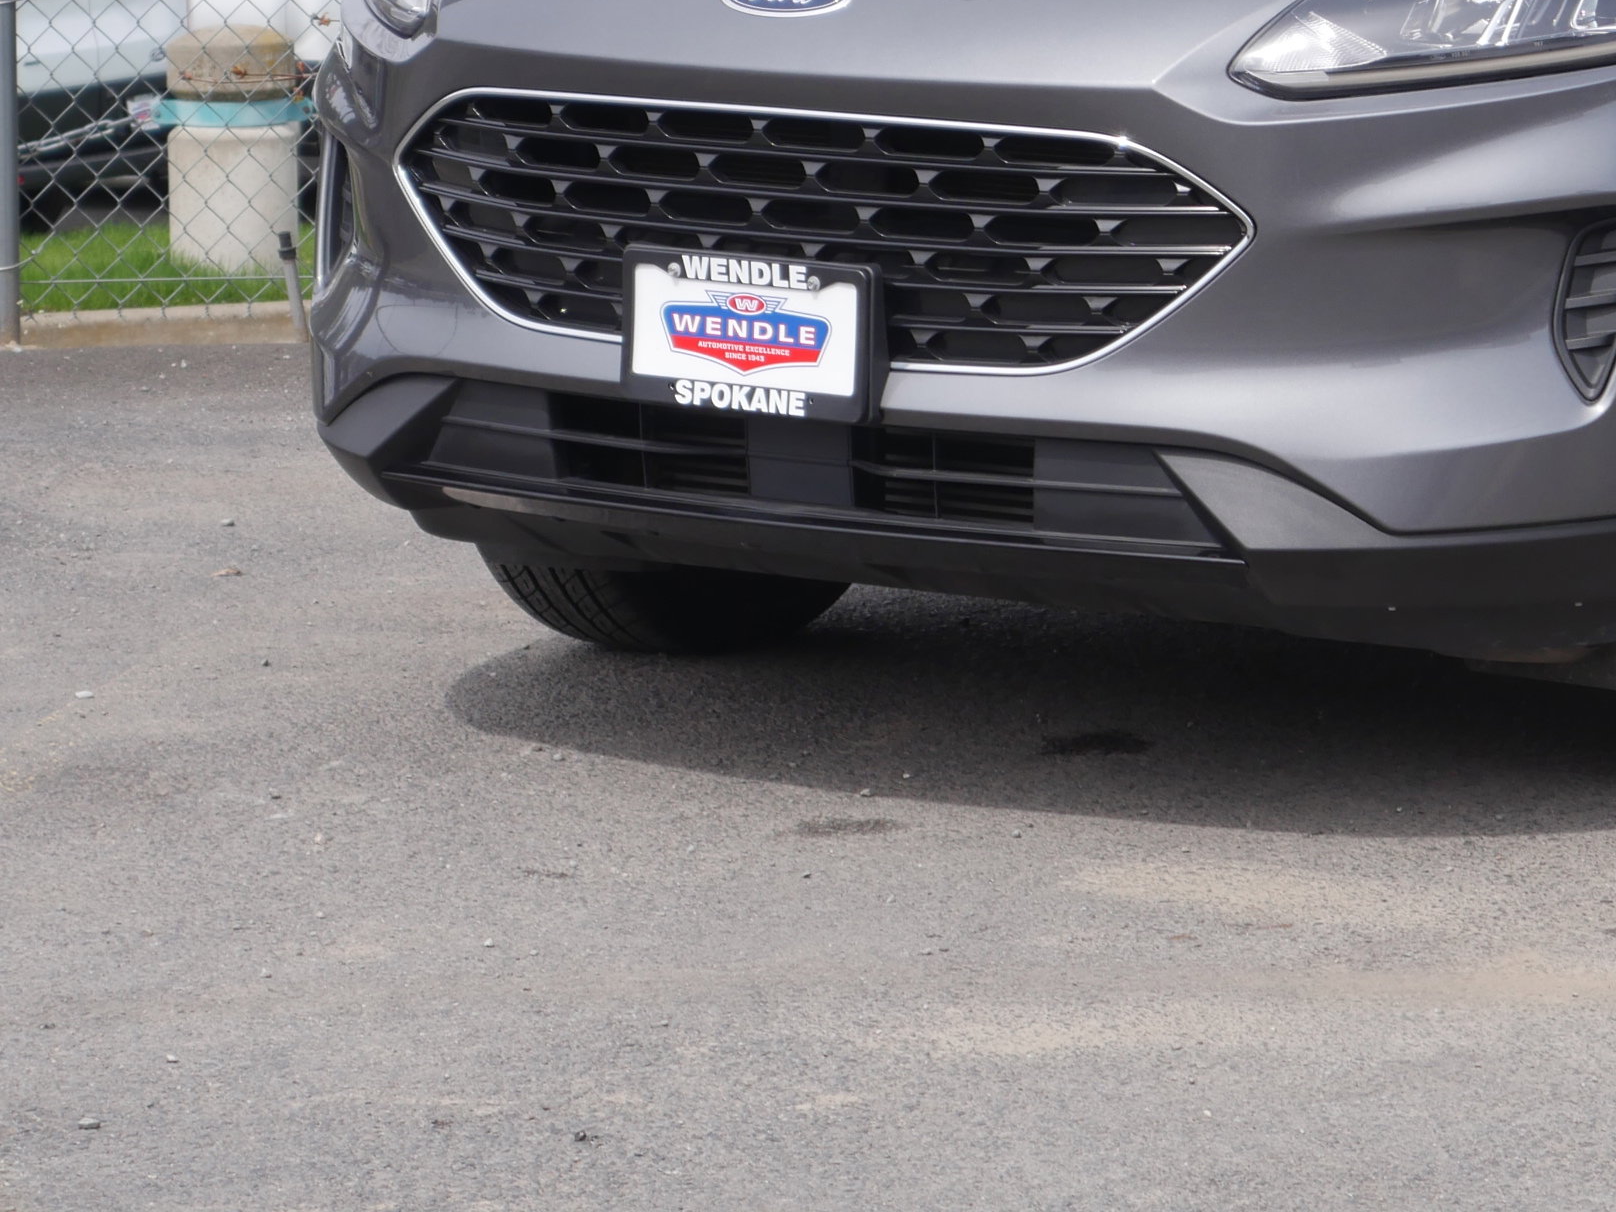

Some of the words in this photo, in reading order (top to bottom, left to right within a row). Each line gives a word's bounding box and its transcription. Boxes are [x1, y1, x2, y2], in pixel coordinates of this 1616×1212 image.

[681, 254, 809, 290] WENDLE
[672, 313, 816, 346] WENDLE
[697, 341, 744, 352] AUTOMOTIVE
[745, 344, 791, 356] EXCELLENCE
[725, 352, 747, 360] SINCE
[674, 379, 806, 417] SPOKANE
